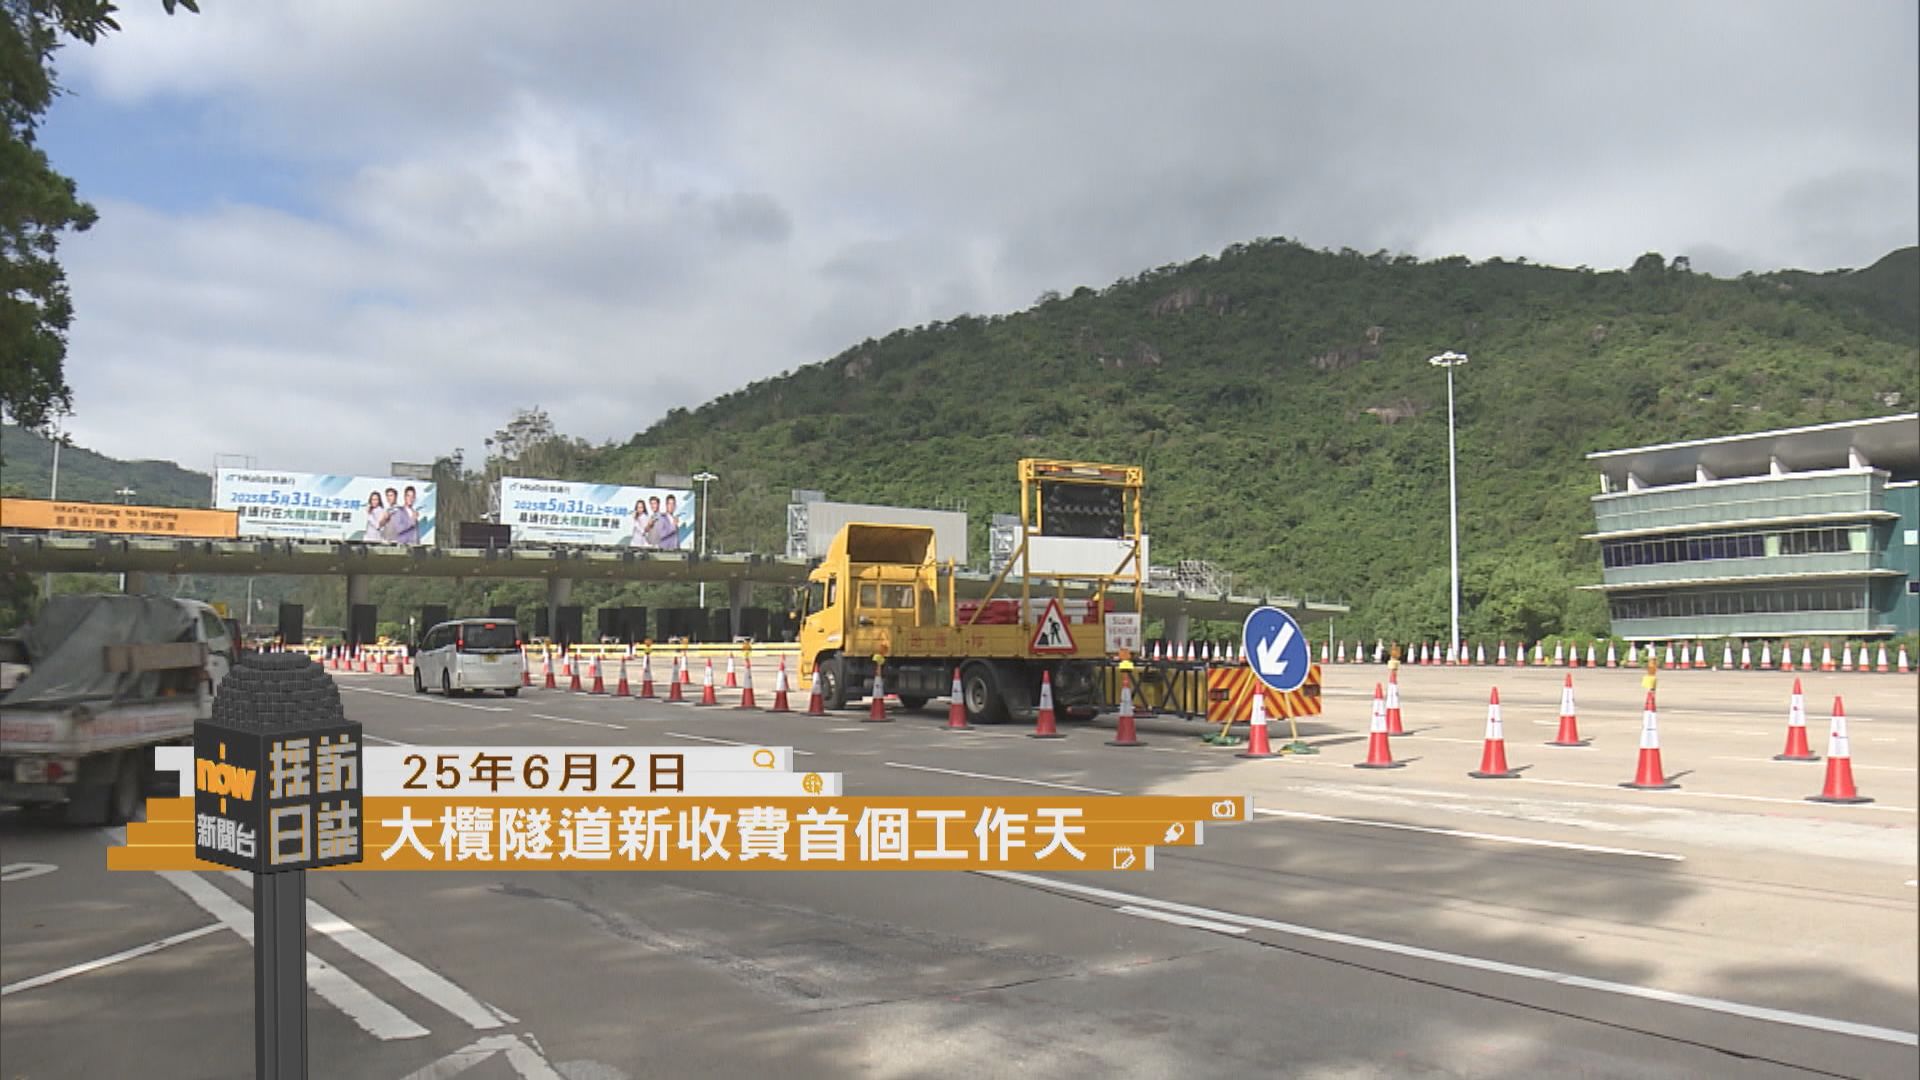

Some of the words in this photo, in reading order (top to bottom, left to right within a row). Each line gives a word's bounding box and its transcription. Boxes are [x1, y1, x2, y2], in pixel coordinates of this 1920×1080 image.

[231, 490, 360, 509] 2025年5月31日上午5時
[514, 498, 628, 516] 2025年5月31日上午5時
[1112, 616, 1133, 625] SLOW
[1108, 626, 1137, 635] VEHICLE
